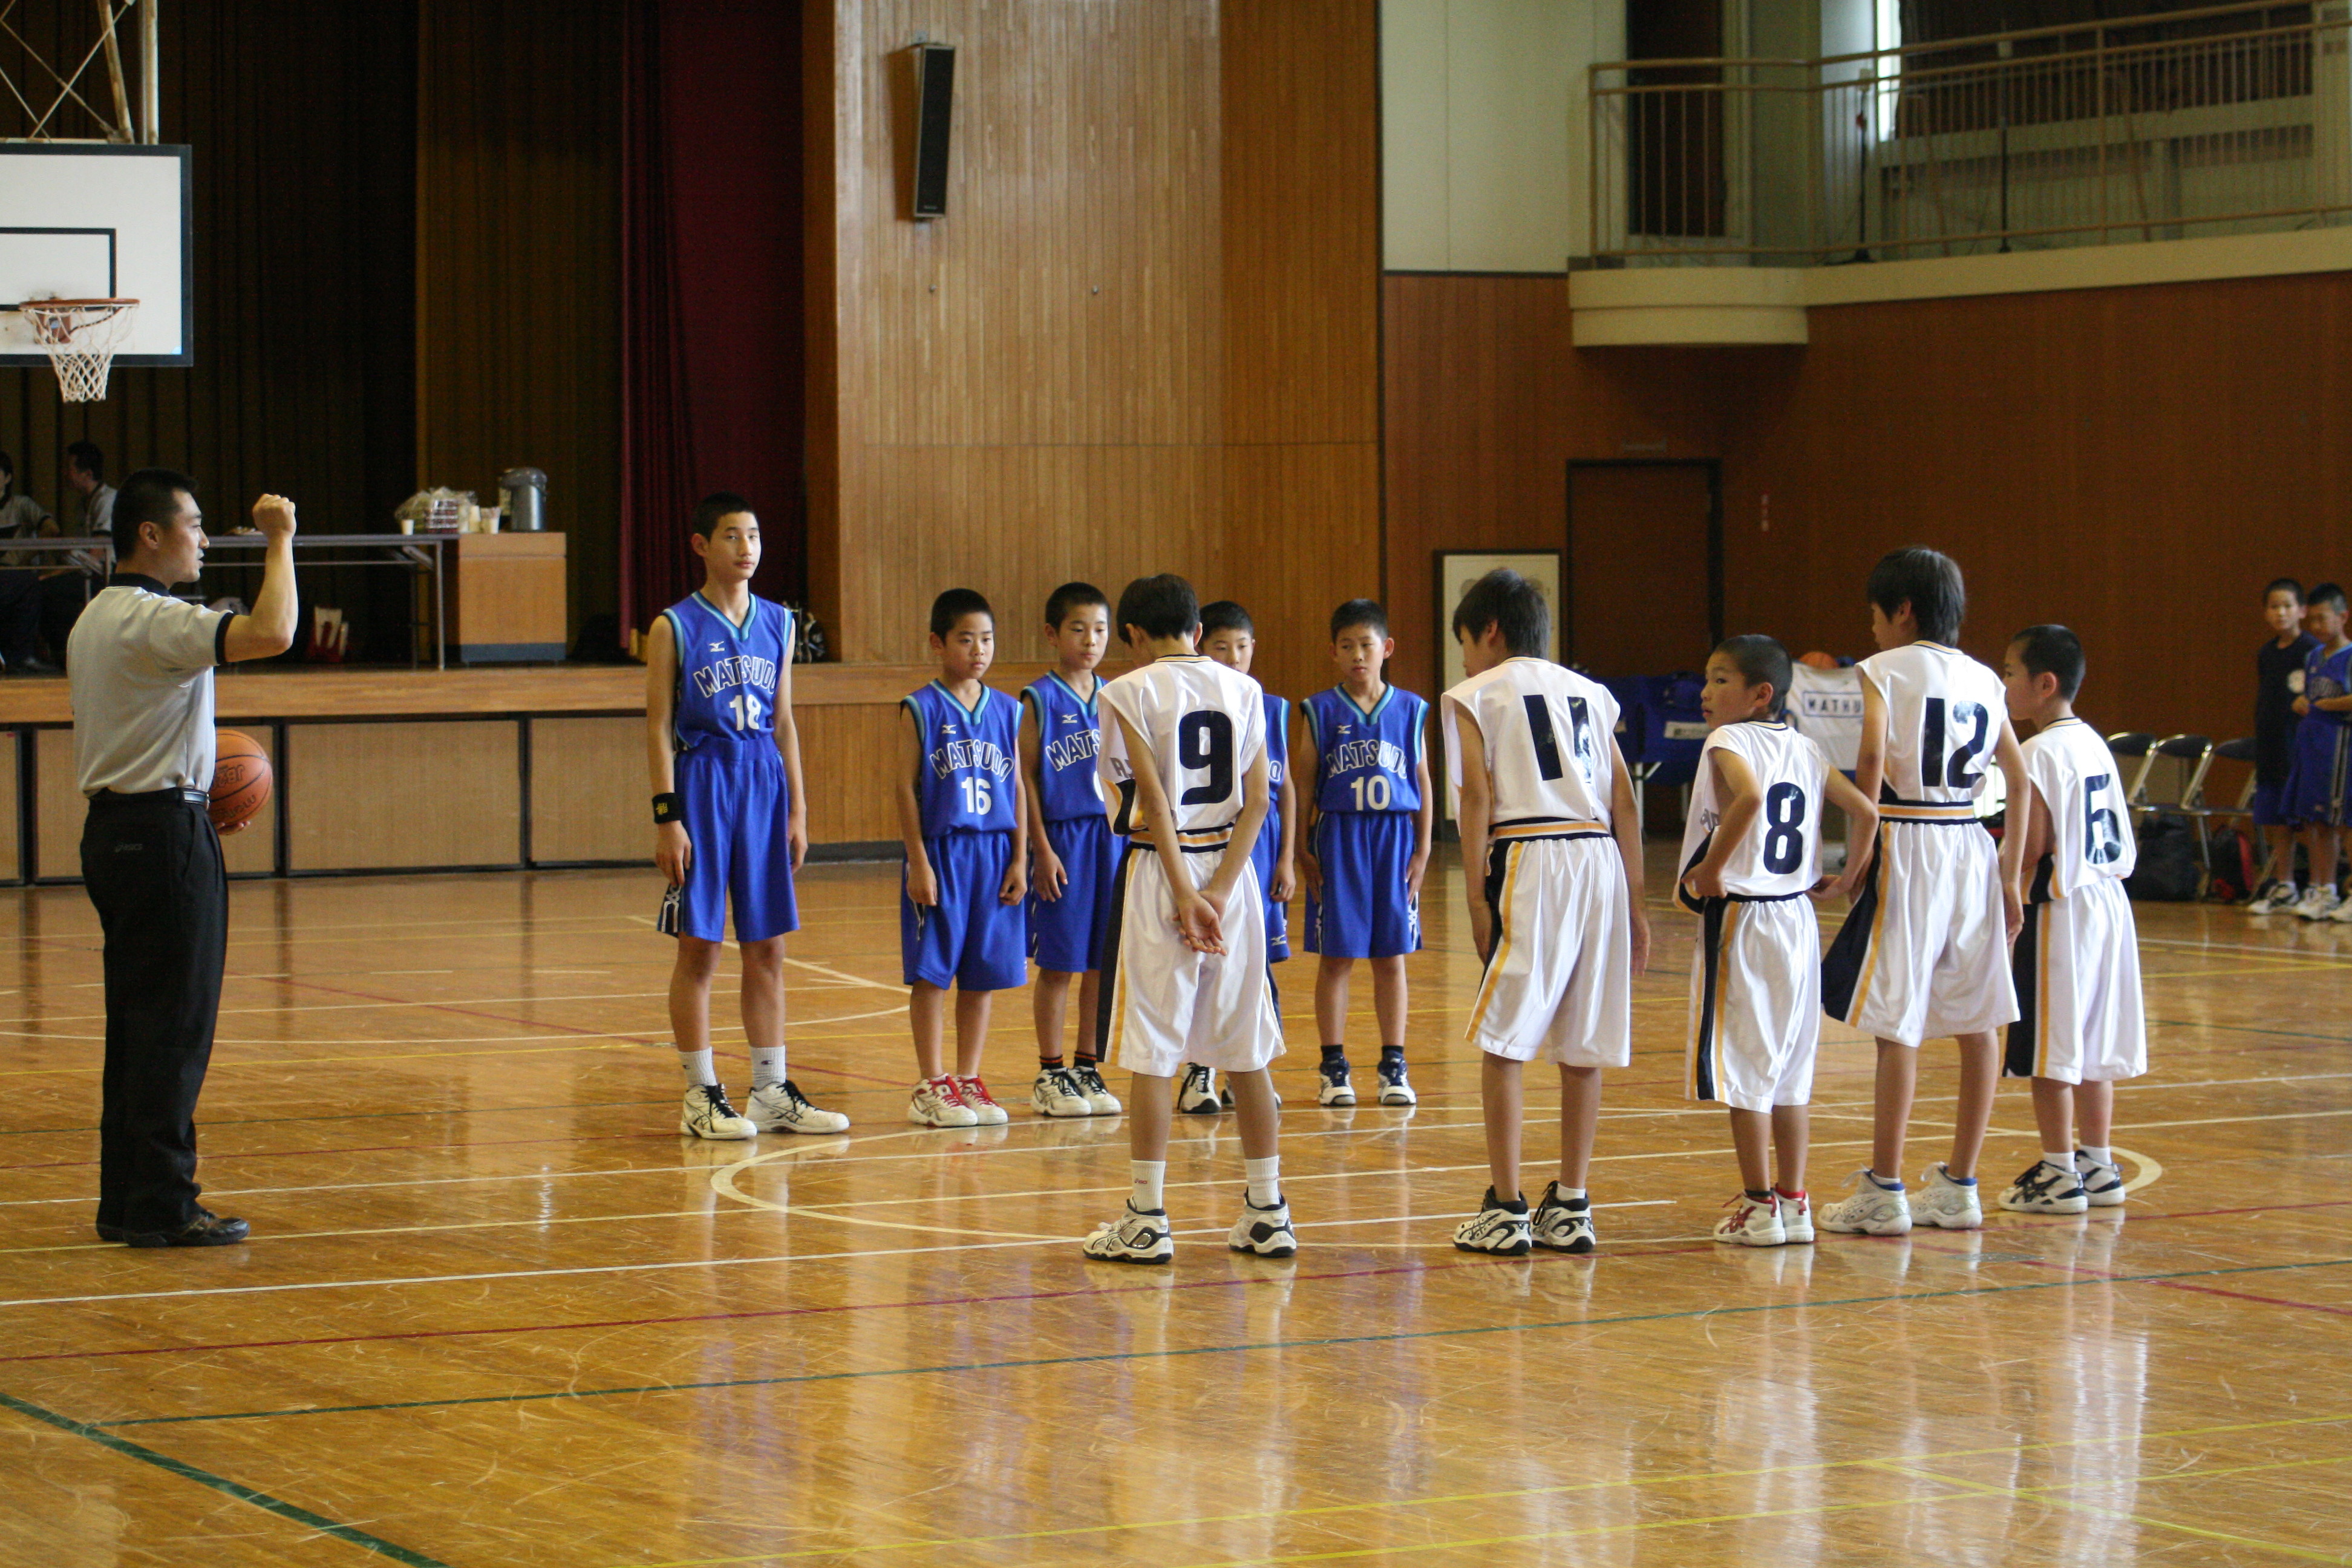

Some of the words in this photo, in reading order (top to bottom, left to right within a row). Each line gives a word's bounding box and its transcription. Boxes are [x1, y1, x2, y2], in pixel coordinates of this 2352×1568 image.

[730, 694, 762, 731] 18
[1922, 697, 1989, 789] 12
[929, 739, 1014, 783] MATSUDO
[1178, 710, 1233, 806] 9
[961, 776, 992, 815] 16
[1350, 774, 1391, 811] 10
[2085, 773, 2121, 864] 6
[1763, 782, 1805, 874] 8
